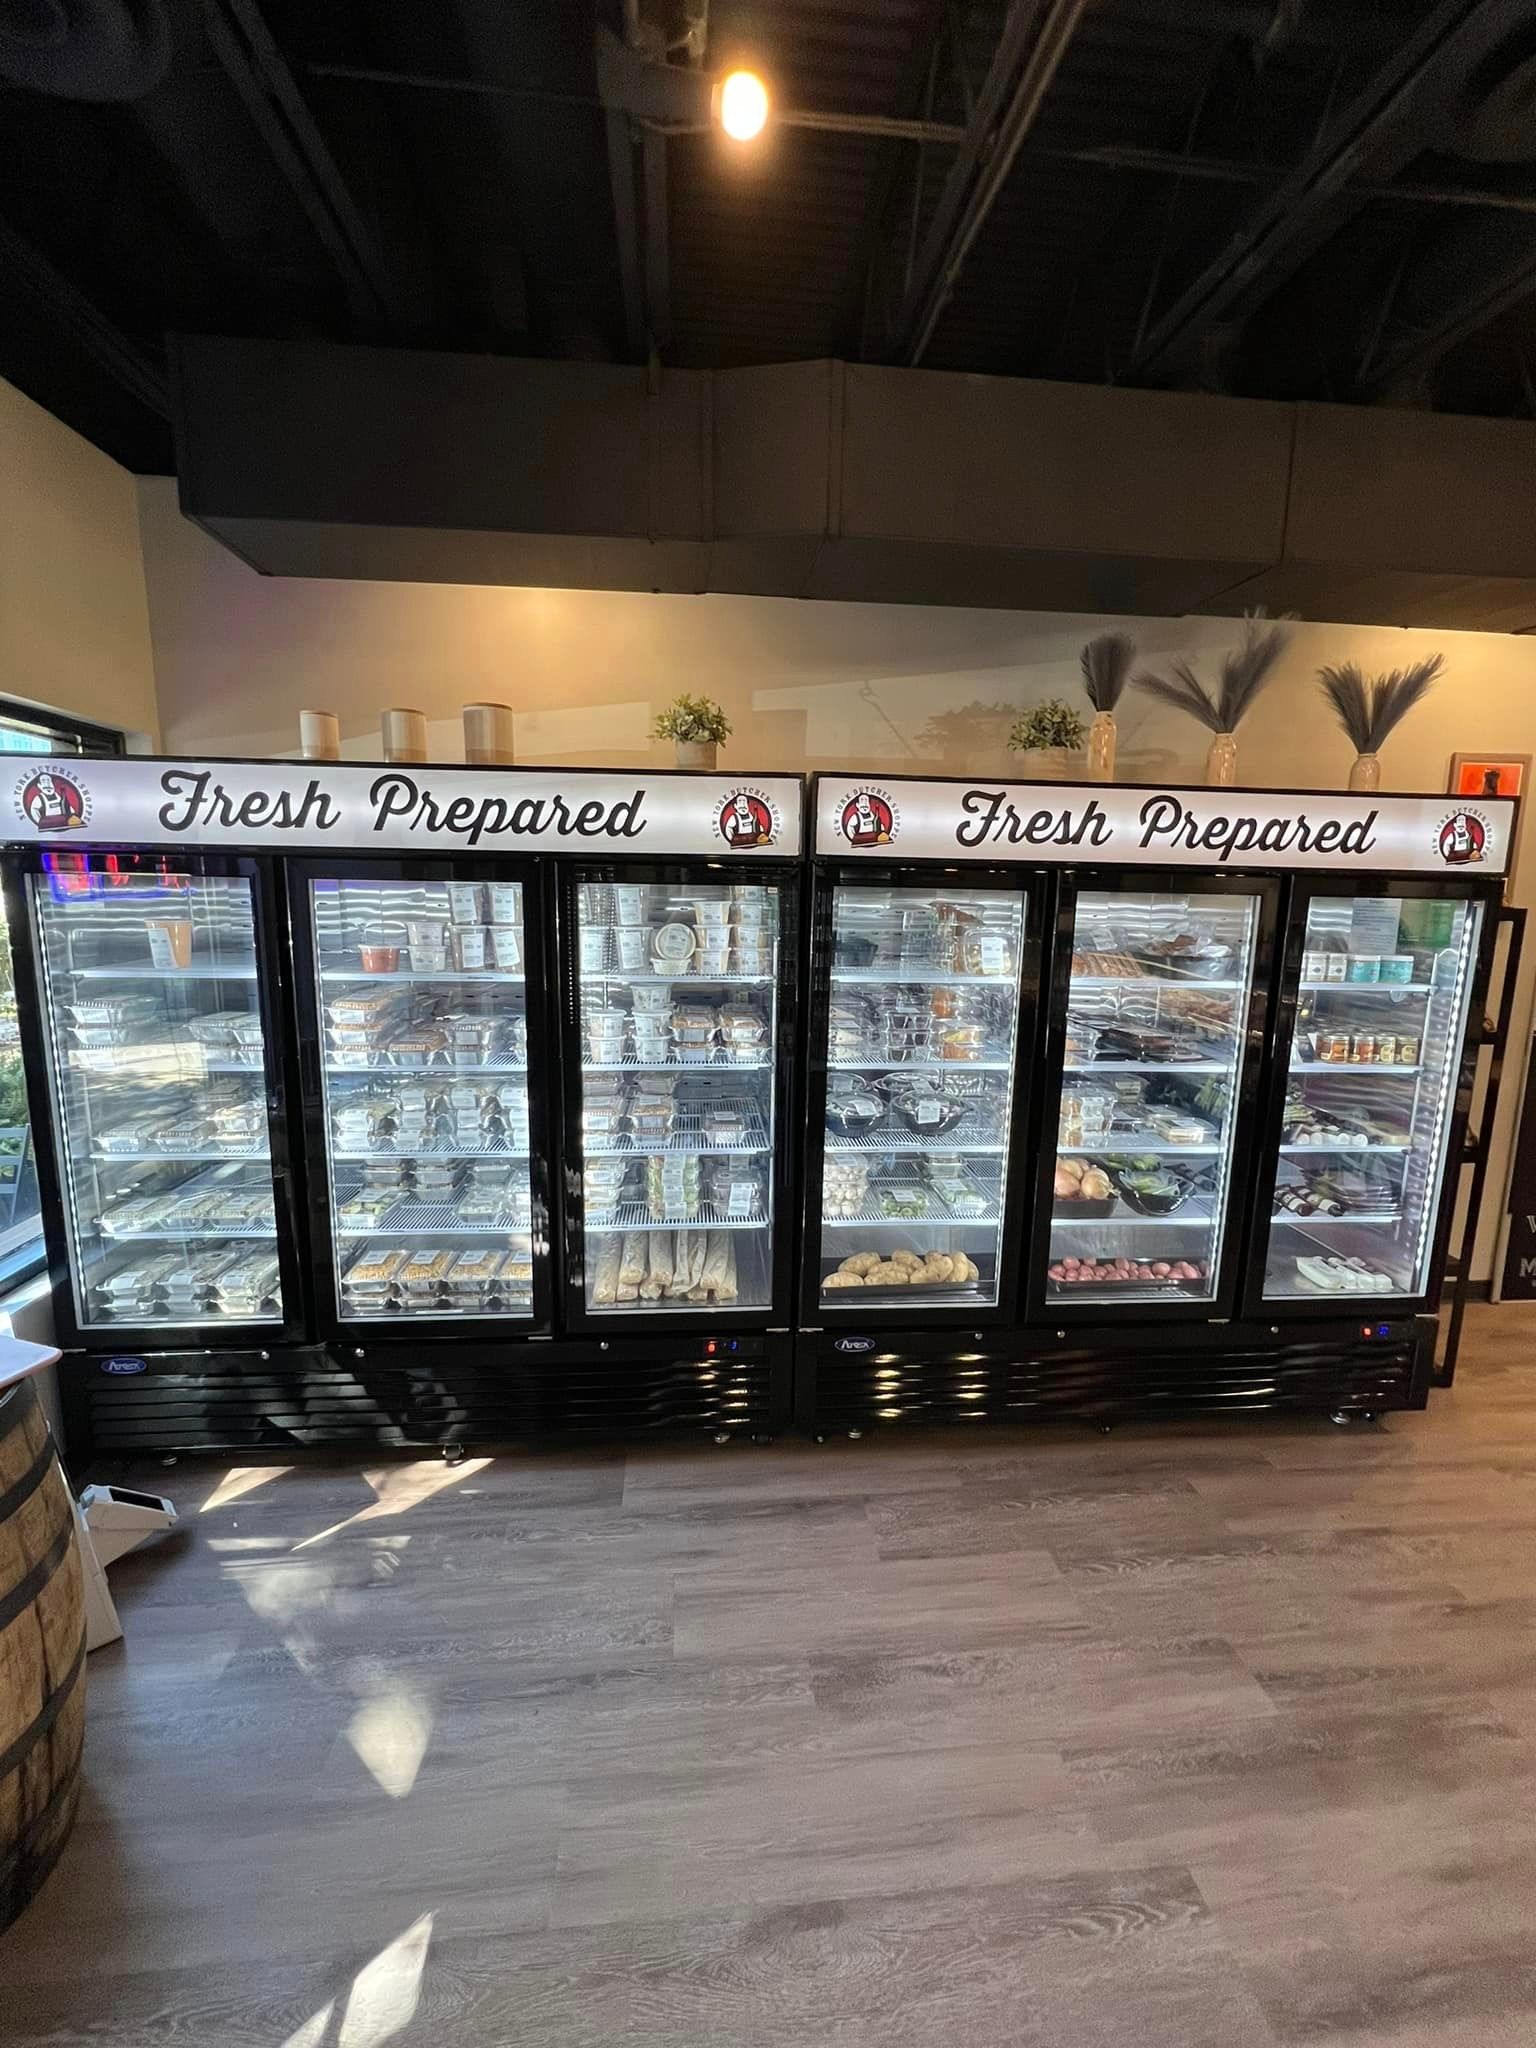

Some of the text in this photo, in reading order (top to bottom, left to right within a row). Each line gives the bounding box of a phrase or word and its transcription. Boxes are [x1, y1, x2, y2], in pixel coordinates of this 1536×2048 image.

[158, 769, 648, 845] Fresh Prepared
[956, 790, 1379, 861] Fresh Prepared
